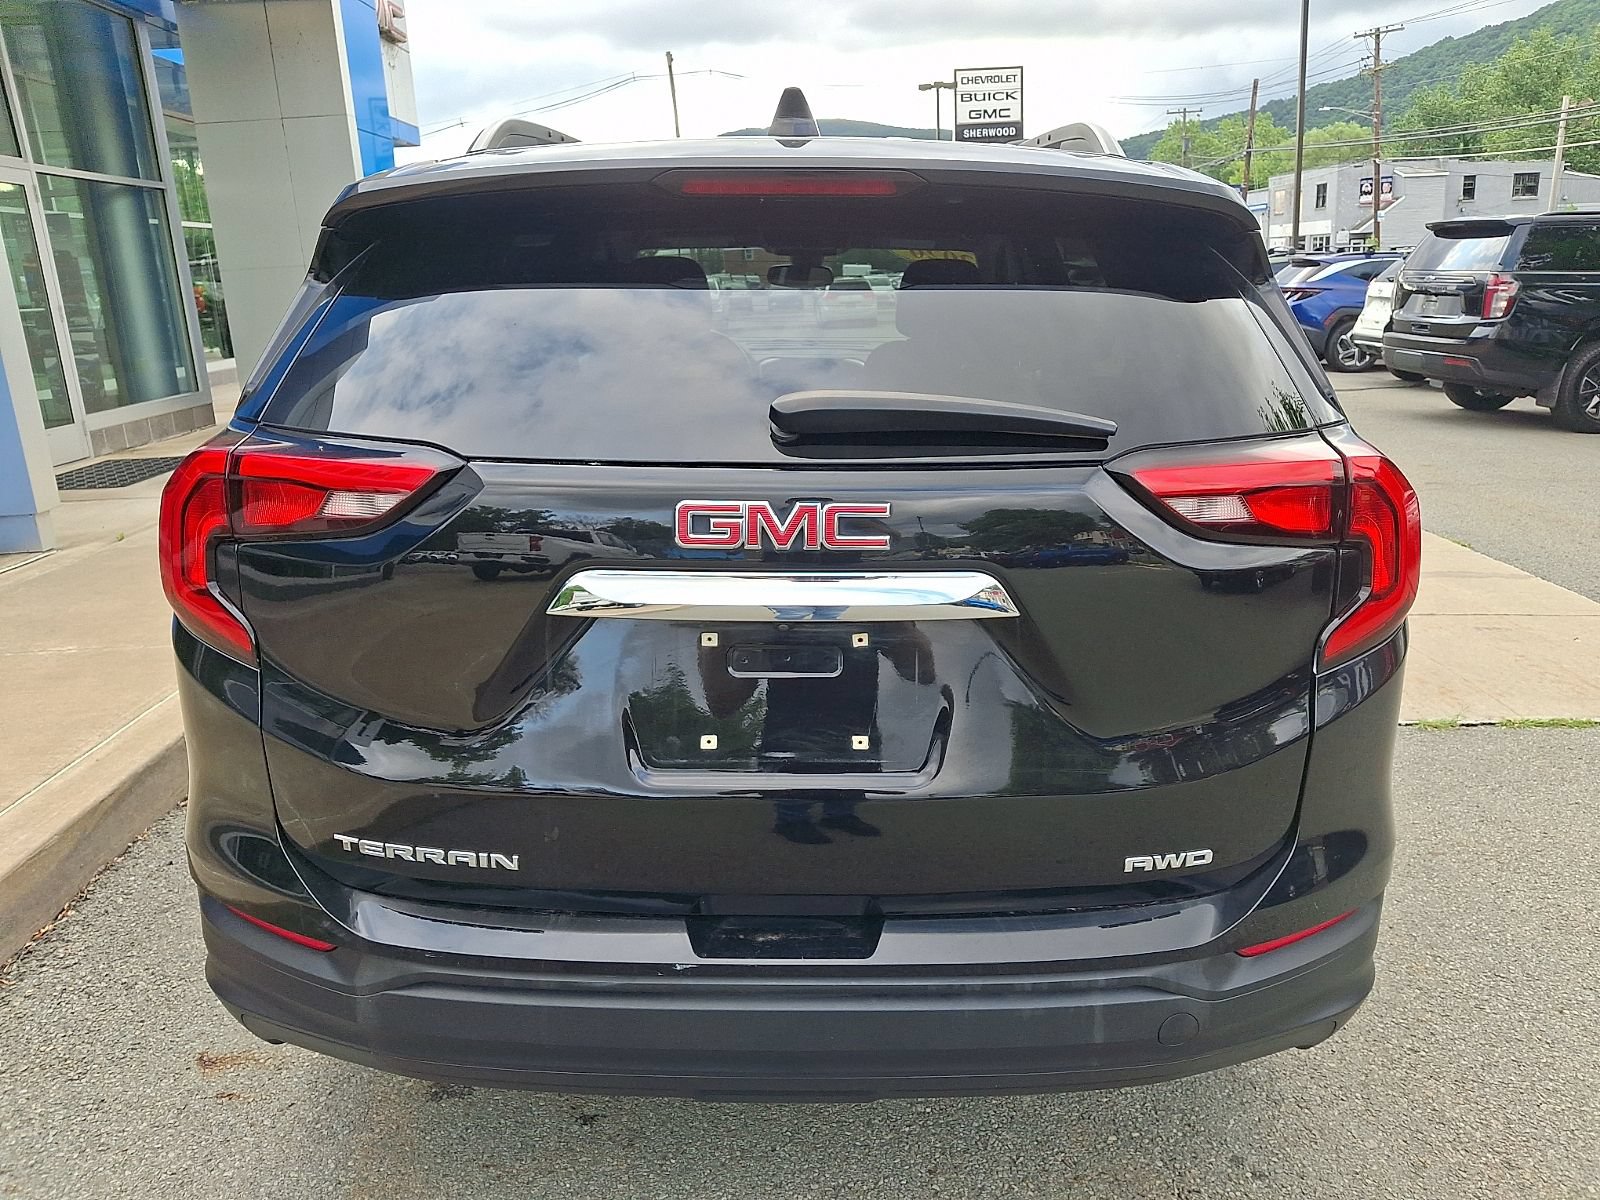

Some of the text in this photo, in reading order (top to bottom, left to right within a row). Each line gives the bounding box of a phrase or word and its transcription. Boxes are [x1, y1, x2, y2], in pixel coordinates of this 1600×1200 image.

[960, 74, 1018, 85] CHEVROLET
[960, 90, 1018, 102] BUICK
[968, 108, 1011, 119] GMC
[963, 127, 1016, 138] SHERWOOD
[675, 499, 890, 550] GMC
[333, 833, 519, 871] TERRAIN
[1123, 848, 1214, 873] AWD
